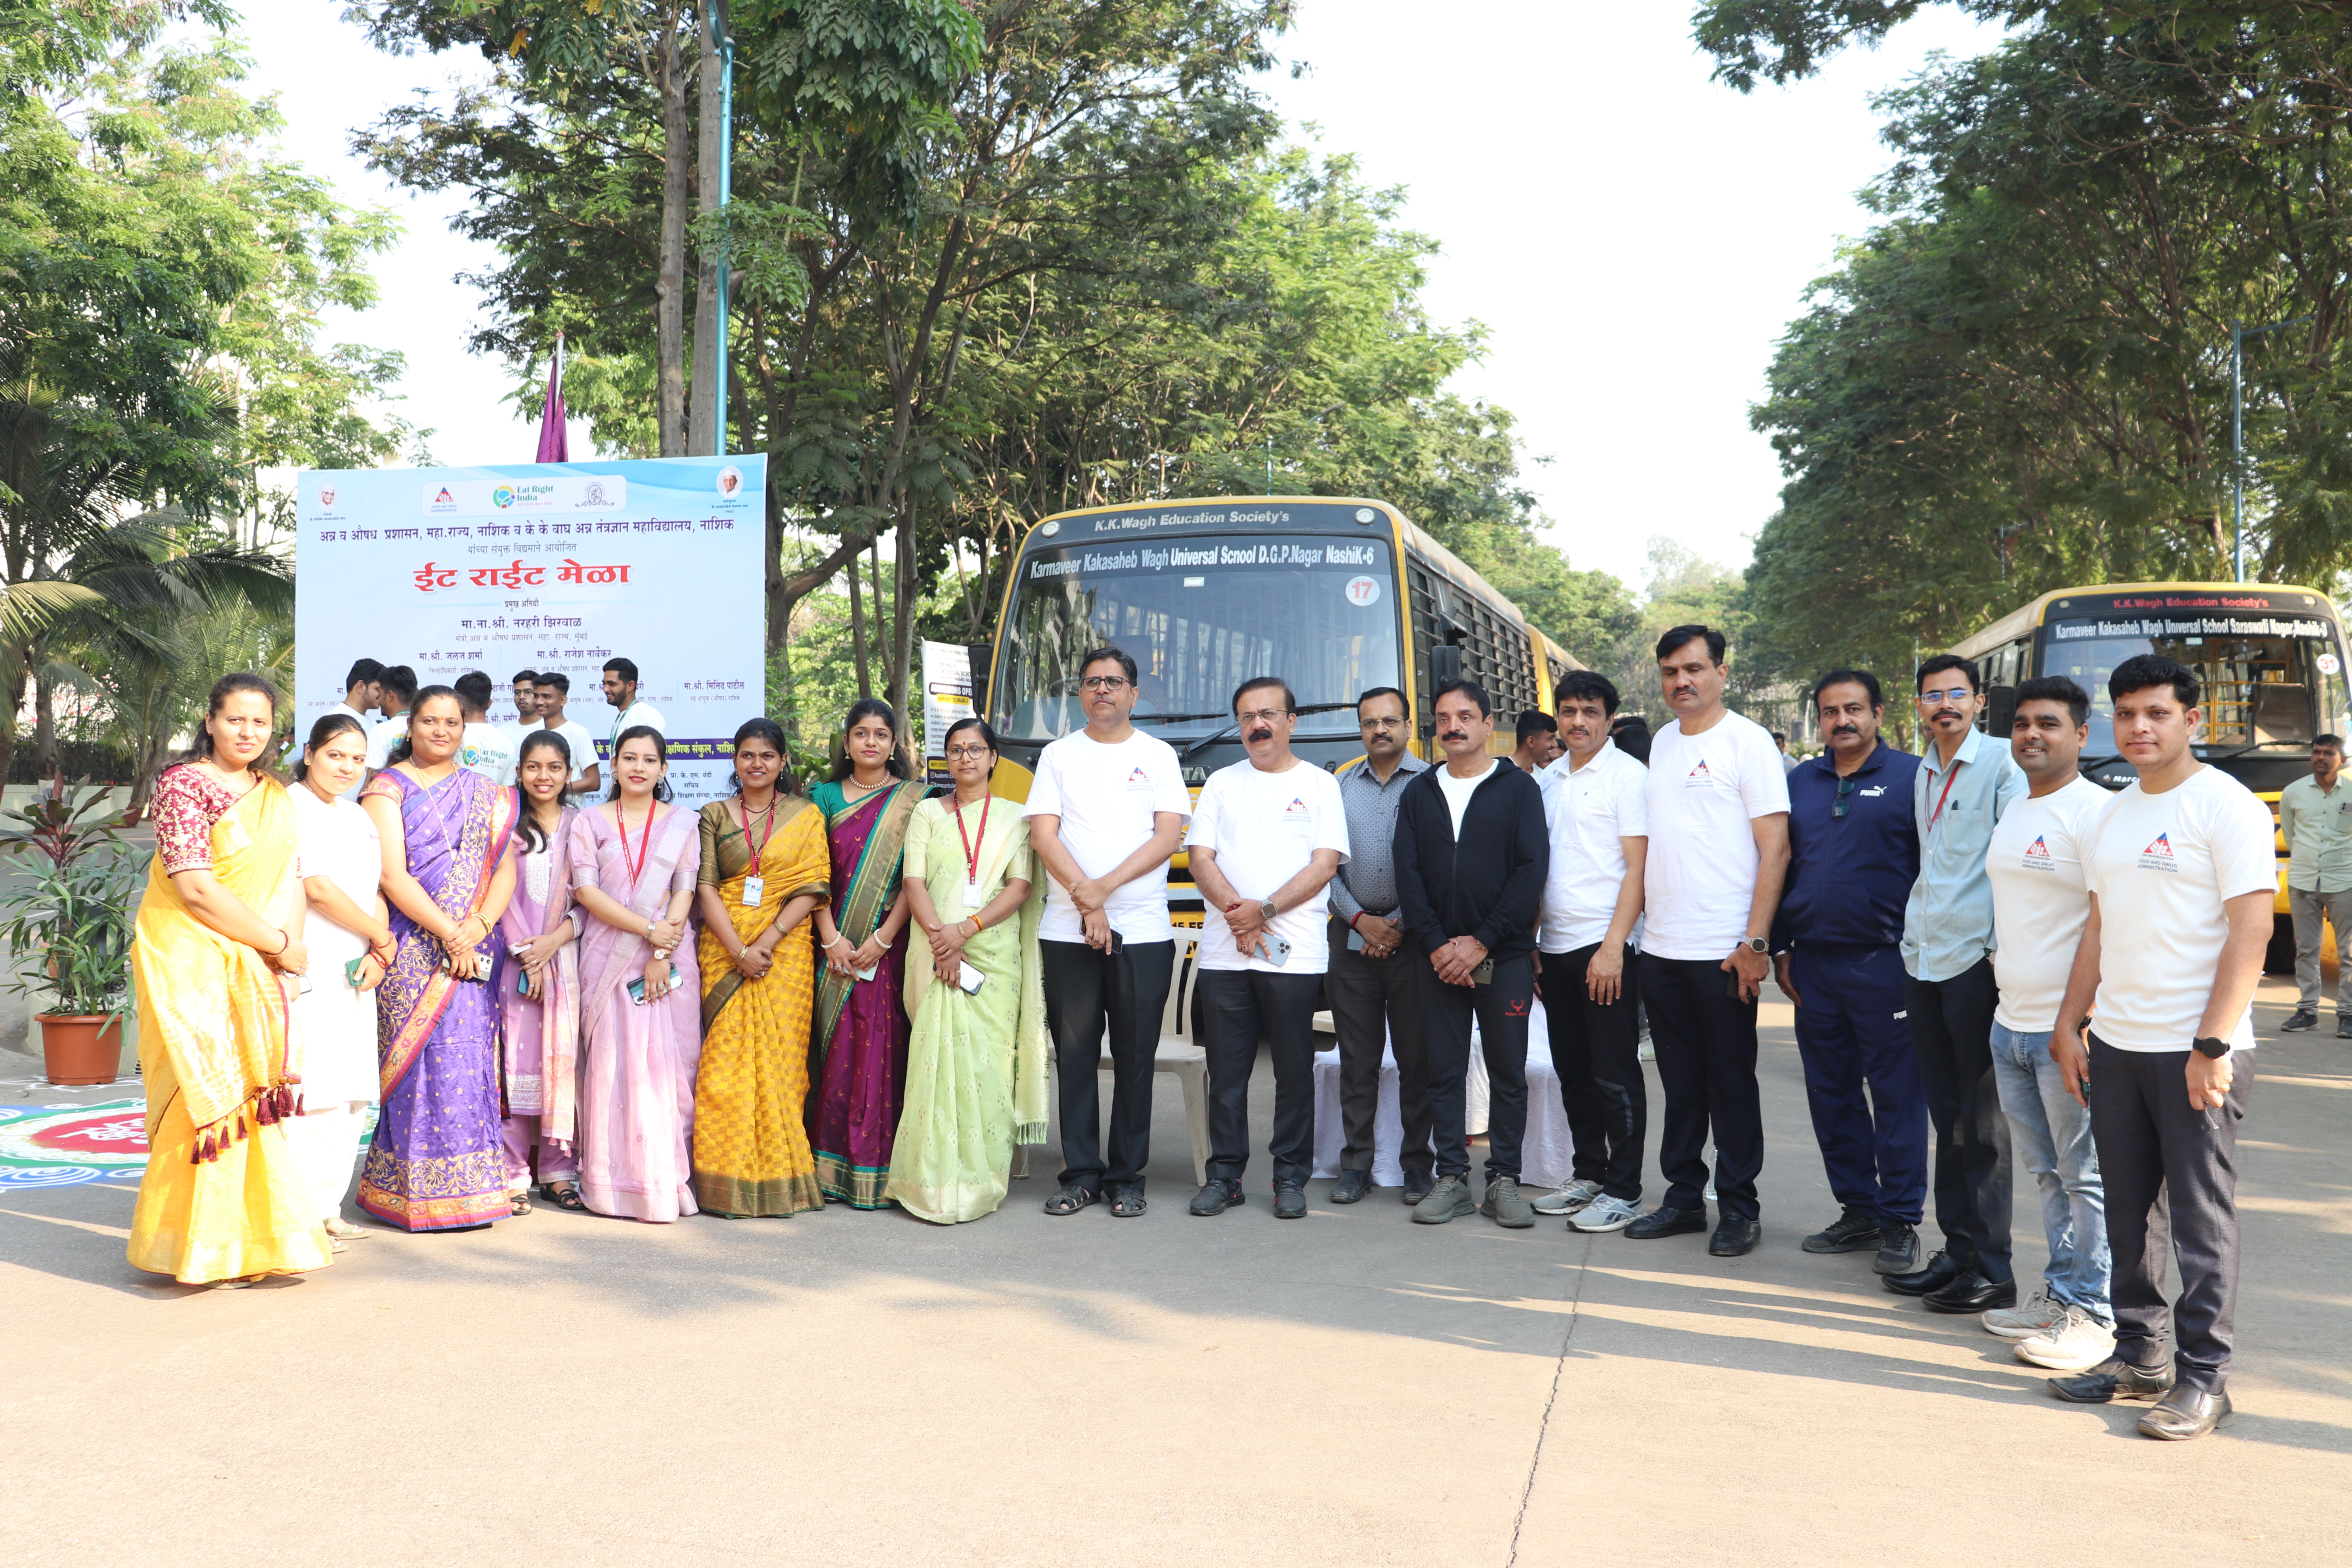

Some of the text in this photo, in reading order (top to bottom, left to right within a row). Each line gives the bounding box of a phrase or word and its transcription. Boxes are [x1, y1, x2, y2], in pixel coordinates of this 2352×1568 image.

[532, 485, 553, 494] Right
[1095, 510, 1289, 531] K.K.Wagh Education Society's
[320, 531, 336, 541] अन्न
[339, 531, 347, 541] व
[351, 525, 377, 540] औषध
[385, 528, 422, 541] प्रशासन,
[477, 522, 510, 537] नाशिक
[514, 525, 521, 535] व
[525, 520, 535, 535] के
[539, 519, 548, 535] के
[552, 524, 571, 534] वाघ
[575, 523, 592, 534] अन्न
[596, 519, 629, 534] तंत्रज्ञान
[633, 517, 695, 534] महाविद्यालय,
[700, 516, 734, 530] नाशिक
[468, 541, 577, 557] यांच्या संयुक्त विद्यमाने आयोजित
[1031, 558, 1081, 579] Karmaveer
[1083, 551, 1138, 570] Kakasaheb
[1141, 549, 1169, 571] Wagh
[1170, 547, 1218, 566] Universal
[413, 559, 631, 592] ईट राईट मेळा
[1352, 581, 1373, 600] 17
[505, 598, 539, 611] प्रमुख अतिथी
[2113, 597, 2269, 609] K.K.Wagh Education Society's
[461, 616, 582, 630] मा.ना.श्री. नरहरी झिरवाळ
[2056, 624, 2096, 639] Karmaveer
[2099, 620, 2140, 637] Kakasaheb
[2142, 619, 2163, 636] Wagh
[2165, 618, 2201, 634] Universal
[2202, 618, 2229, 634] School
[2230, 617, 2269, 634] Saraswati
[491, 632, 509, 641] औषध
[512, 634, 535, 642] प्रशासन,
[575, 632, 588, 642] मुंबई
[419, 648, 483, 661] मा.श्री. जलज शर्मा
[537, 646, 611, 659] मा.श्री. राजेश नार्वेकर
[557, 664, 570, 672] औषध
[2320, 658, 2336, 670] 31
[684, 679, 744, 690] मा.श्री. मिलिंद पाटील
[962, 688, 973, 696] OPE
[491, 750, 508, 760] Right
[691, 741, 715, 758] संकुल,
[585, 792, 603, 802] संकुल,
[696, 791, 712, 799] संस्था,
[2138, 864, 2178, 873] ADMINISTRATION
[1893, 1010, 1907, 1020] PUM
